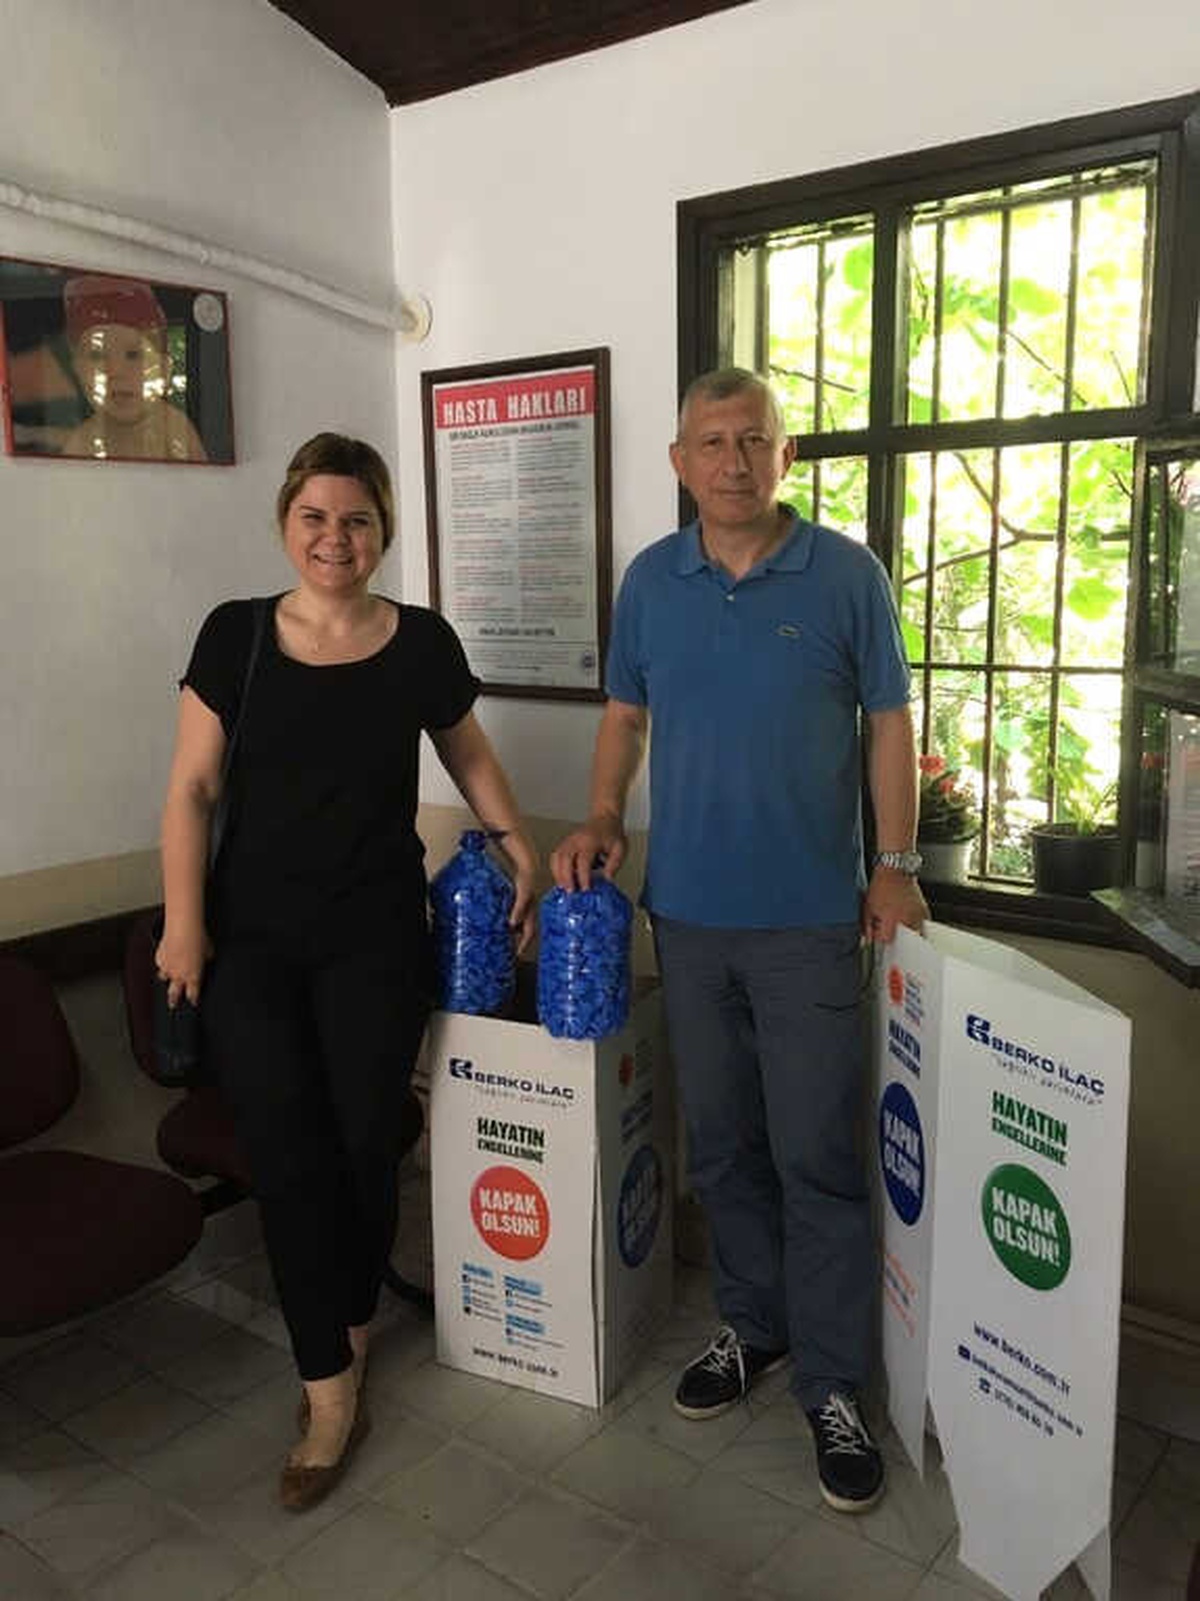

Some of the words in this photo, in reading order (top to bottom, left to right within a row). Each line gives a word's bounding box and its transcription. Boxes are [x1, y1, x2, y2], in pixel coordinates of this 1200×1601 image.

[443, 397, 498, 426] HASTA
[507, 386, 586, 419] HAKLARI
[992, 1037, 1055, 1074] BERKO
[474, 1072, 533, 1093] BERKO
[477, 1116, 545, 1148] HAYATIN
[992, 1090, 1067, 1147] HAYATIN
[478, 1186, 537, 1216] KAPAK
[992, 1187, 1057, 1238] KAPAK
[482, 1211, 541, 1238] OLSUN!
[993, 1216, 1061, 1267] OLSUN!
